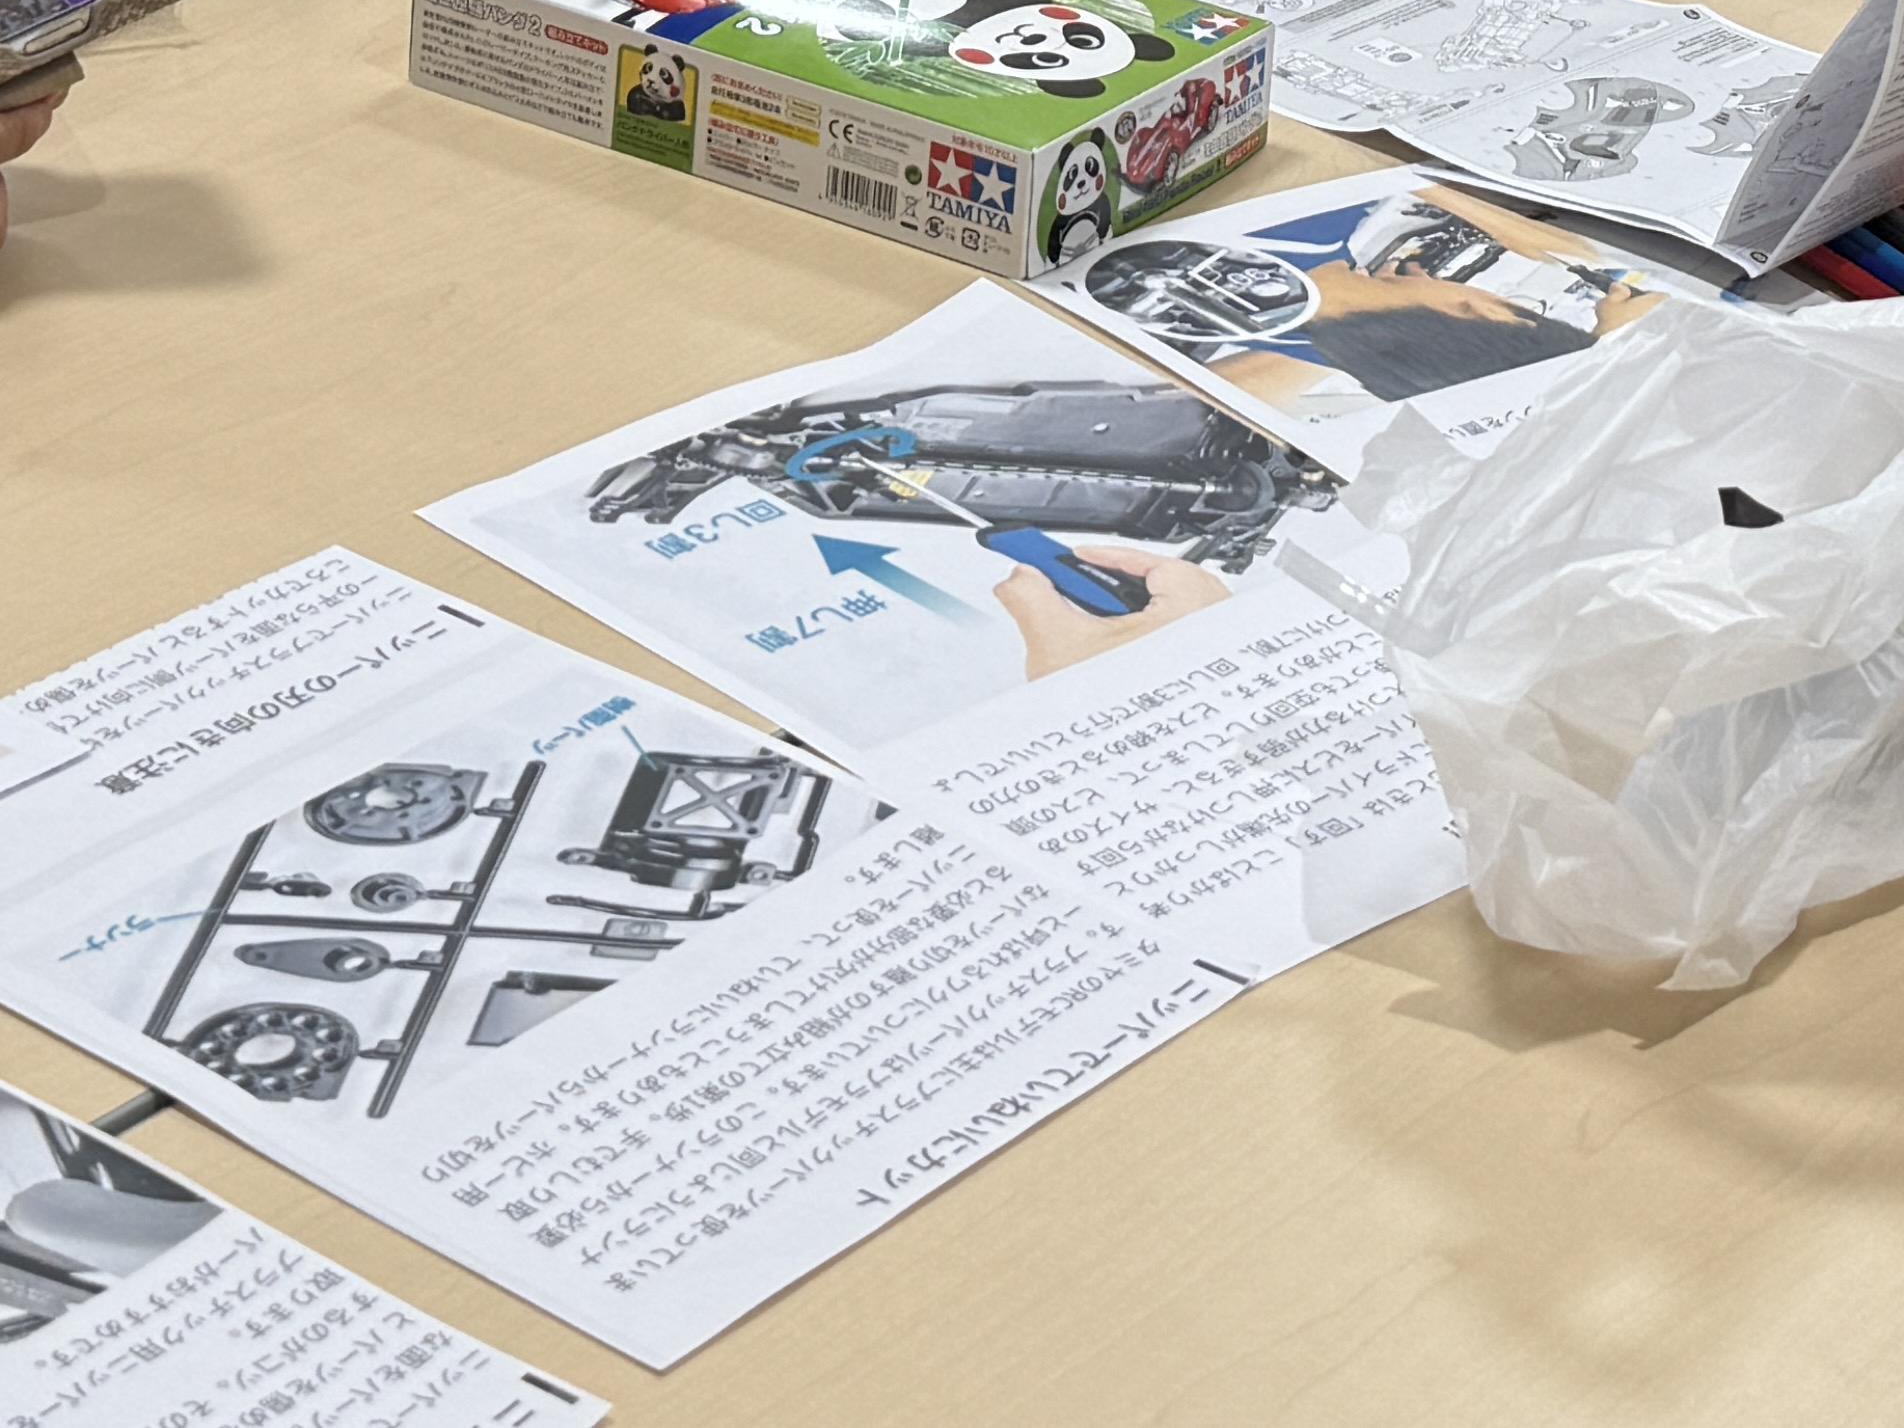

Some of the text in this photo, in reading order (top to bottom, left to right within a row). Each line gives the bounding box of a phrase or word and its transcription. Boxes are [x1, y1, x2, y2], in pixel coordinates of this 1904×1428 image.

[1224, 92, 1264, 124] TAMIYA
[925, 191, 1013, 234] TAMIYA
[632, 496, 796, 560] 回し3割
[732, 586, 900, 656] 押し7割
[91, 616, 452, 802] ニッパーの刃の向きに注意
[838, 823, 951, 890] 離します。
[43, 910, 162, 967] ランナー
[409, 843, 985, 1186] ニッパーを使って、ていねいにランナーからパーツを切り
[444, 863, 1021, 1208] ると必要な部分が欠けてしまうこともあります。ホビー用
[491, 881, 1060, 1223] なパーツを切り離すのが組み立ての第1歩。手でむしり取
[562, 919, 1132, 1269] す。プラスチックパーツはプラモデルと同じようにランナ
[596, 937, 1169, 1295] タミヤのRCモデルは主にプラスチックパーツを使っていま
[840, 977, 1222, 1213] ニッパーでていねいにカット
[33, 1224, 266, 1372] パーがおすすめです。
[227, 1267, 345, 1339] 取ります。
